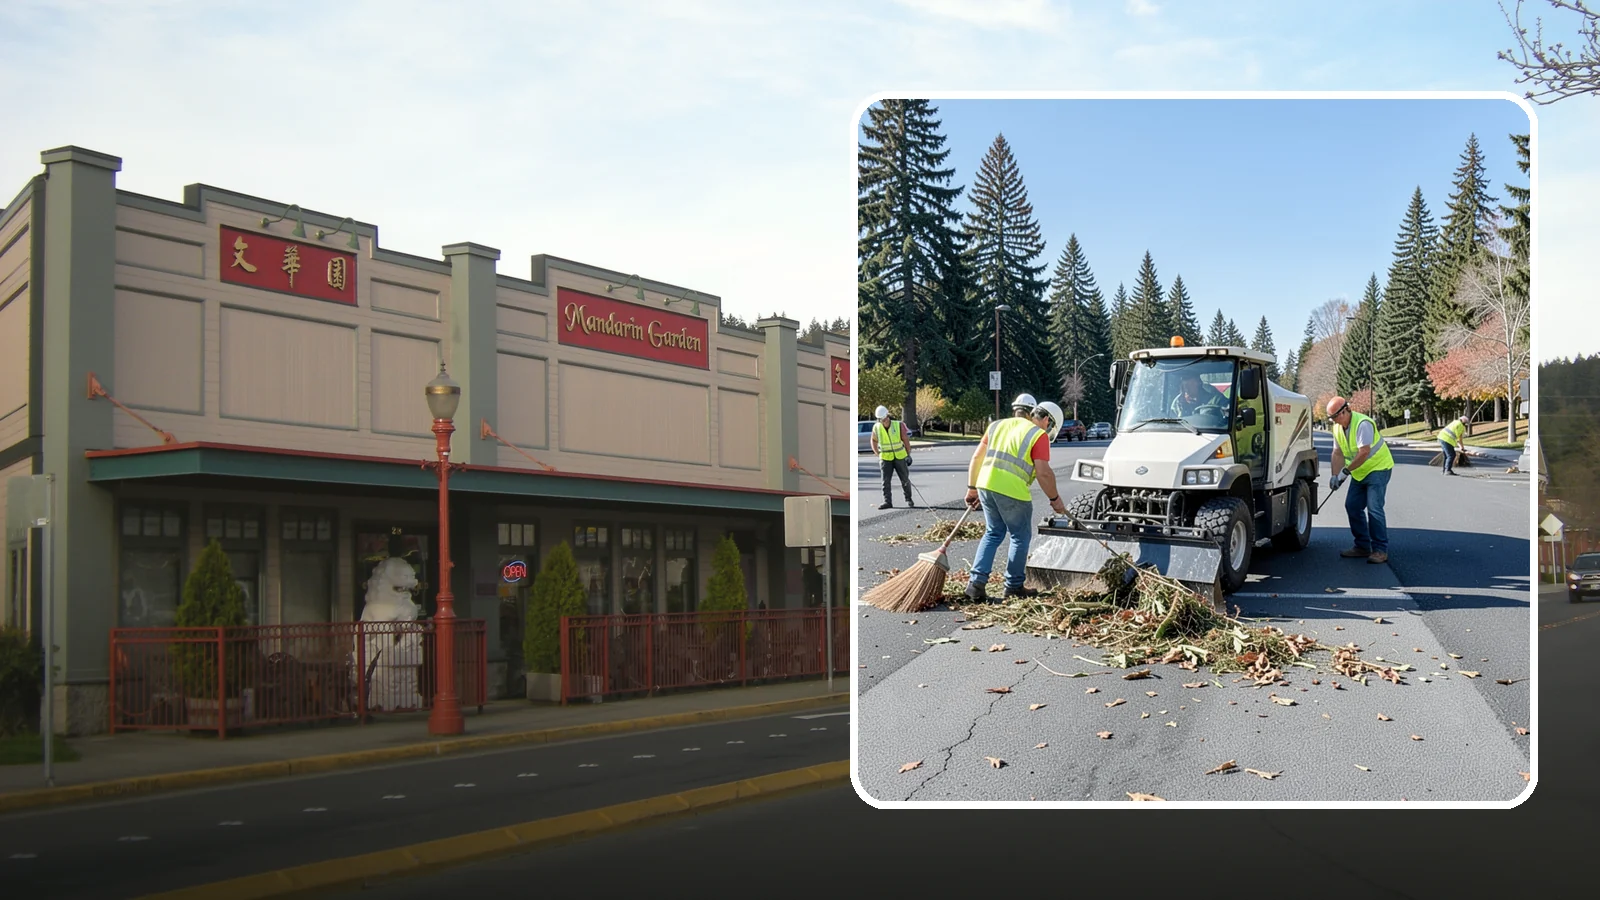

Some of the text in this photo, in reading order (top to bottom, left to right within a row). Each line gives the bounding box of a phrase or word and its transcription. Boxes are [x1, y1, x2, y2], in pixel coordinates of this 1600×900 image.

[230, 235, 347, 291] 文華園
[564, 302, 702, 352] Mandarin Garden
[503, 565, 527, 578] OPEN
